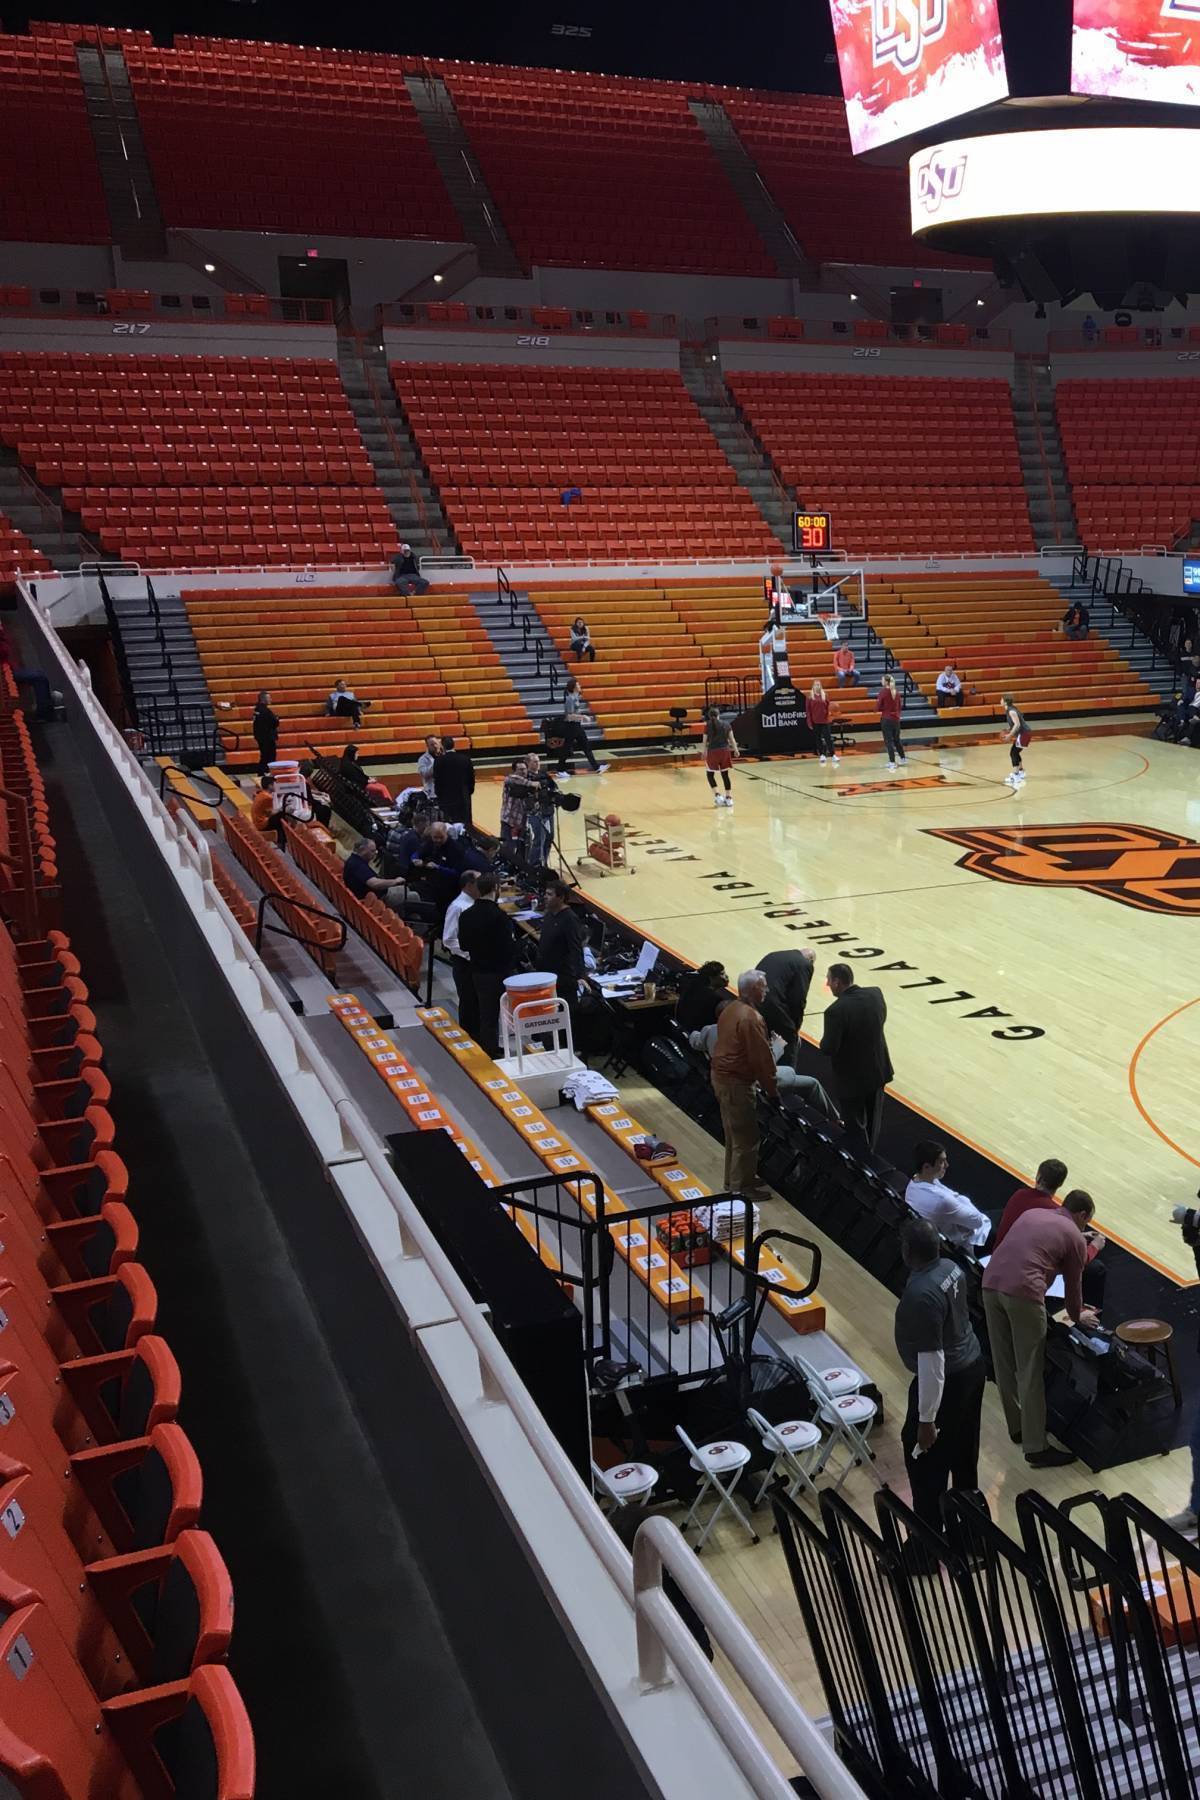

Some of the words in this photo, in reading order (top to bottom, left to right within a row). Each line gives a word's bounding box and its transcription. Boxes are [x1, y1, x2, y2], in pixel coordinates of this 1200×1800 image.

[551, 23, 593, 38] 325
[112, 323, 151, 335] 217
[516, 335, 550, 347] 218
[853, 347, 881, 357] 219
[798, 516, 826, 527] 60:00
[802, 527, 823, 547] 30
[778, 719, 798, 727] BANK
[524, 1018, 561, 1029] GATORADE
[6, 1508, 20, 1531] 2
[14, 1645, 28, 1669] 1
